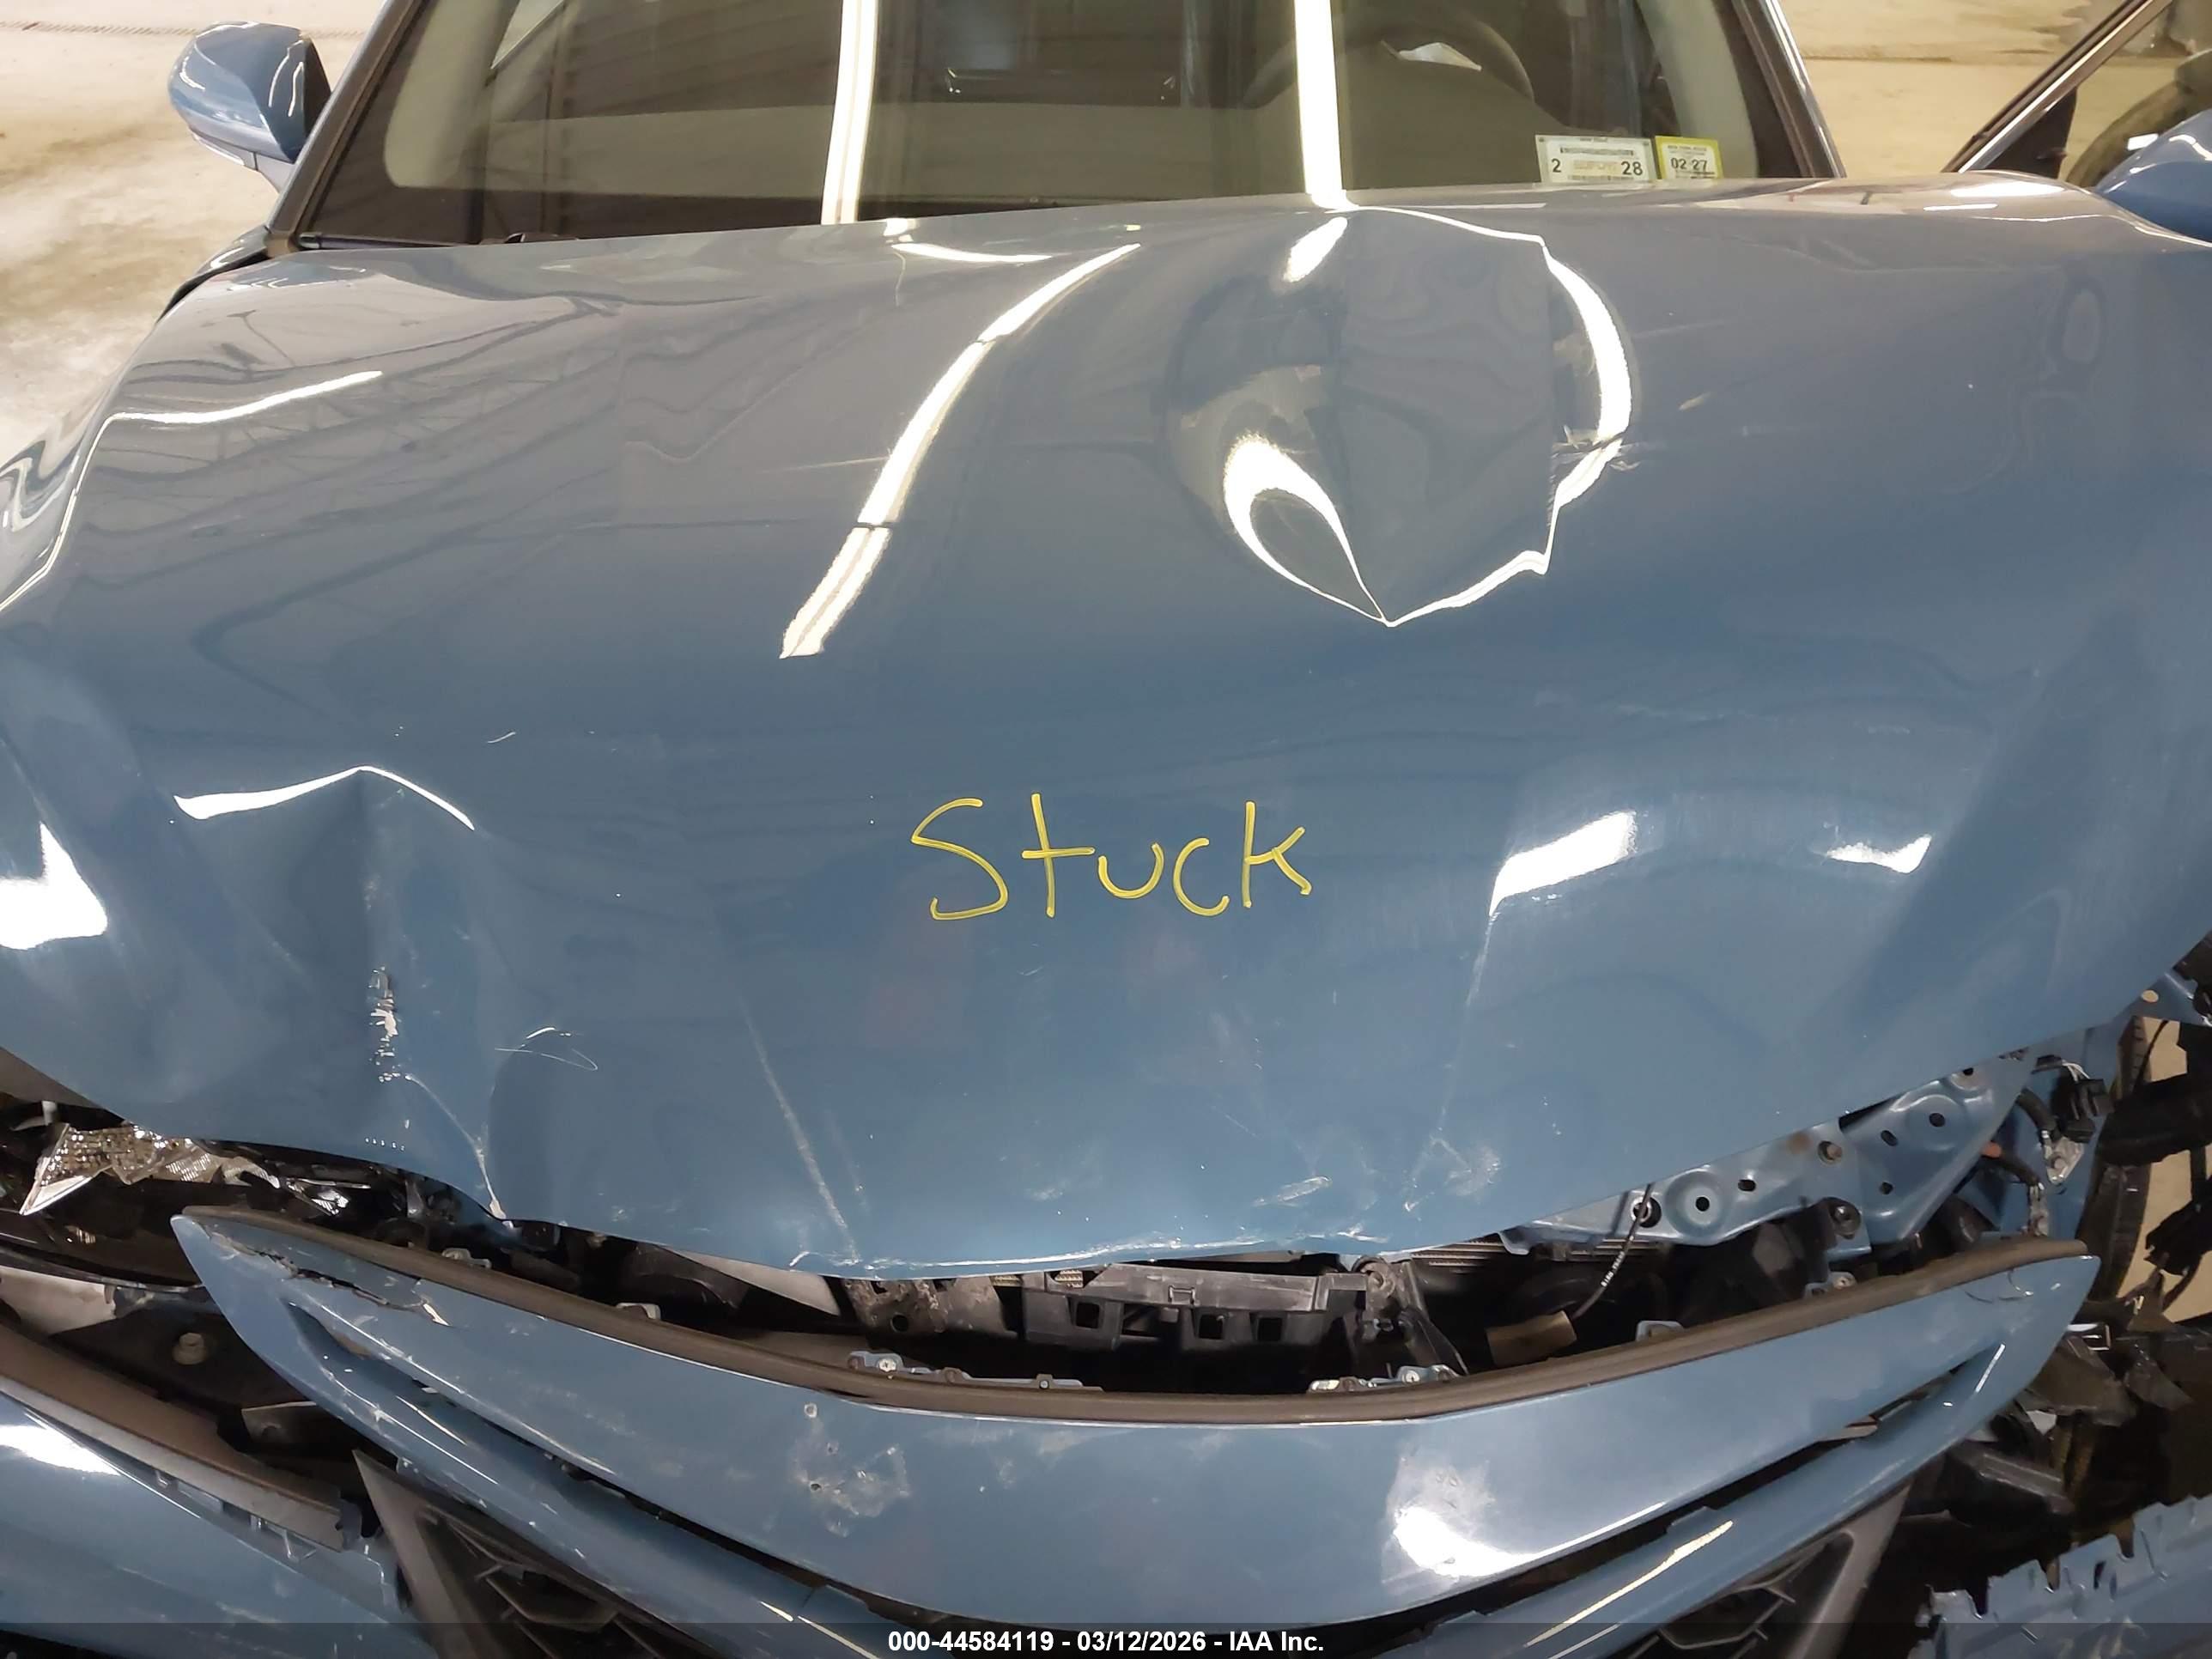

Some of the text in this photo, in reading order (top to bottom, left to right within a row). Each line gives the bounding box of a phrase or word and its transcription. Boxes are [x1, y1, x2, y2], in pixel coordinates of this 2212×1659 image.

[1551, 158, 1562, 173] 2
[1620, 161, 1644, 176] 28
[1670, 157, 1708, 172] 02 27
[910, 792, 1312, 921] Stuck
